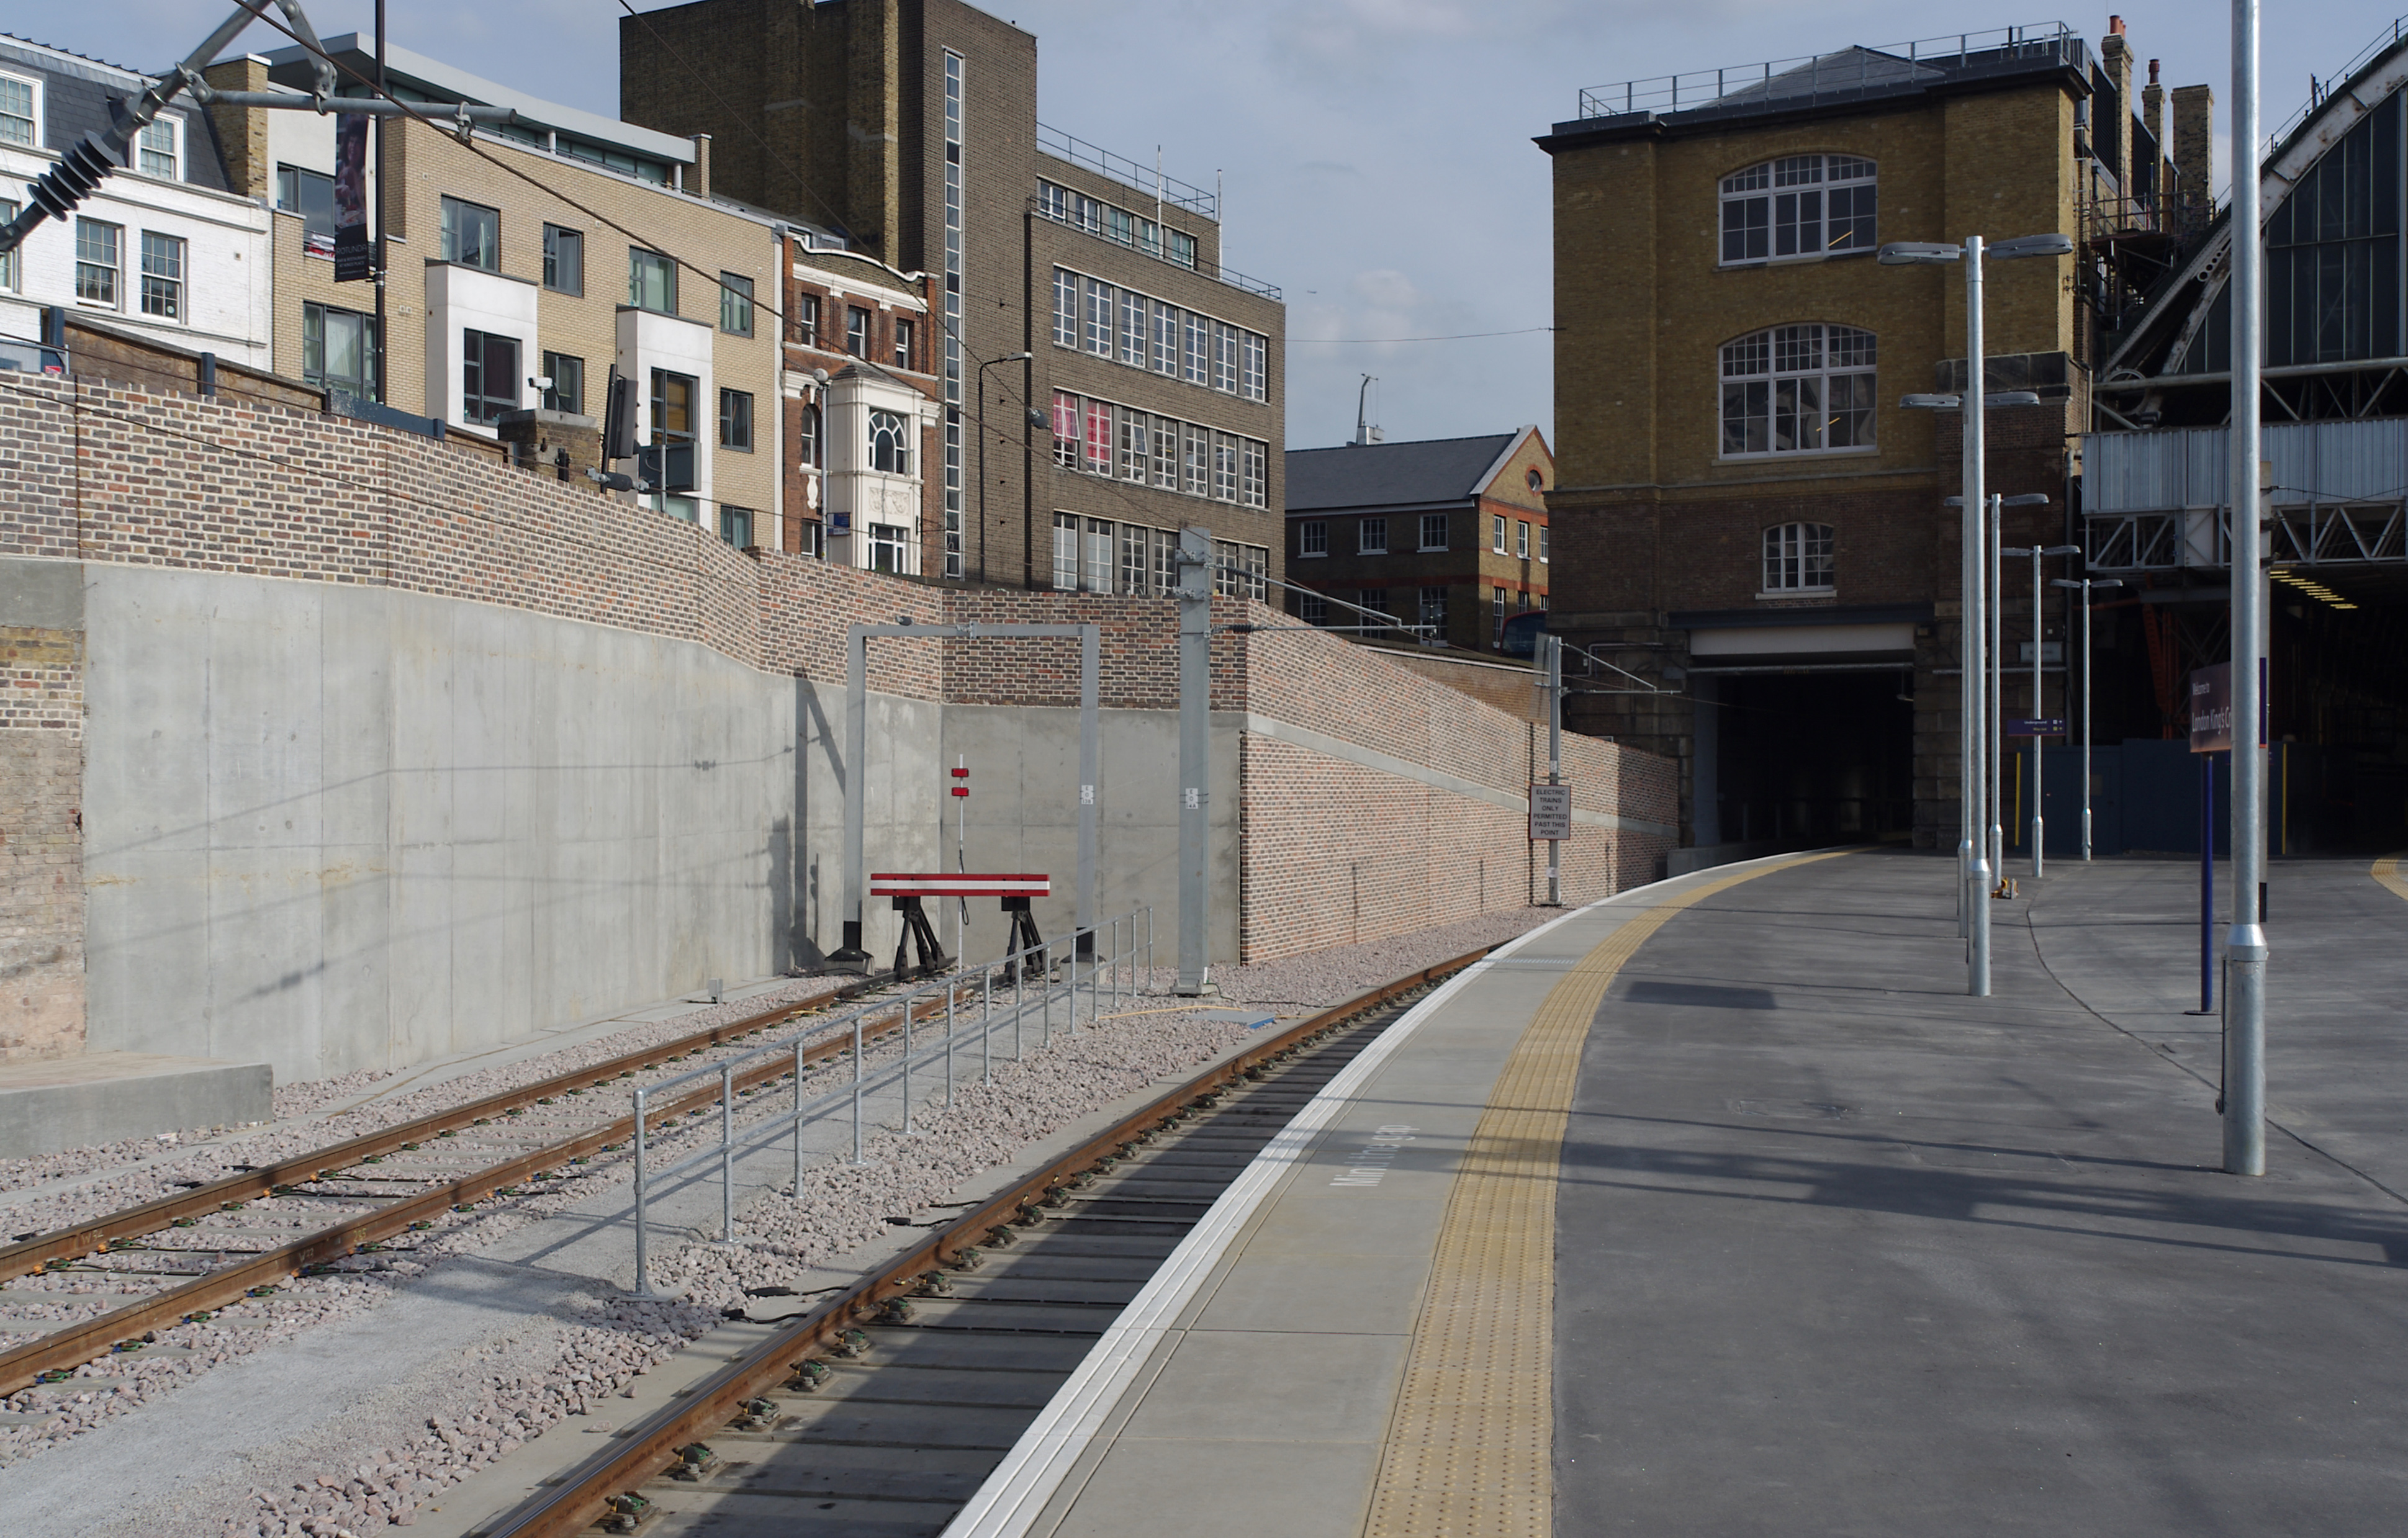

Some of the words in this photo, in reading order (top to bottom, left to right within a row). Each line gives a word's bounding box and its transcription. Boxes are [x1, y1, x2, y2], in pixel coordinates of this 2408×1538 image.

[336, 245, 366, 254] ROTUNDA
[2192, 709, 2209, 732] London
[2210, 706, 2224, 735] King's
[1371, 1125, 1420, 1141] gap
[1348, 1144, 1401, 1159] the
[1329, 1161, 1391, 1186] Mind
